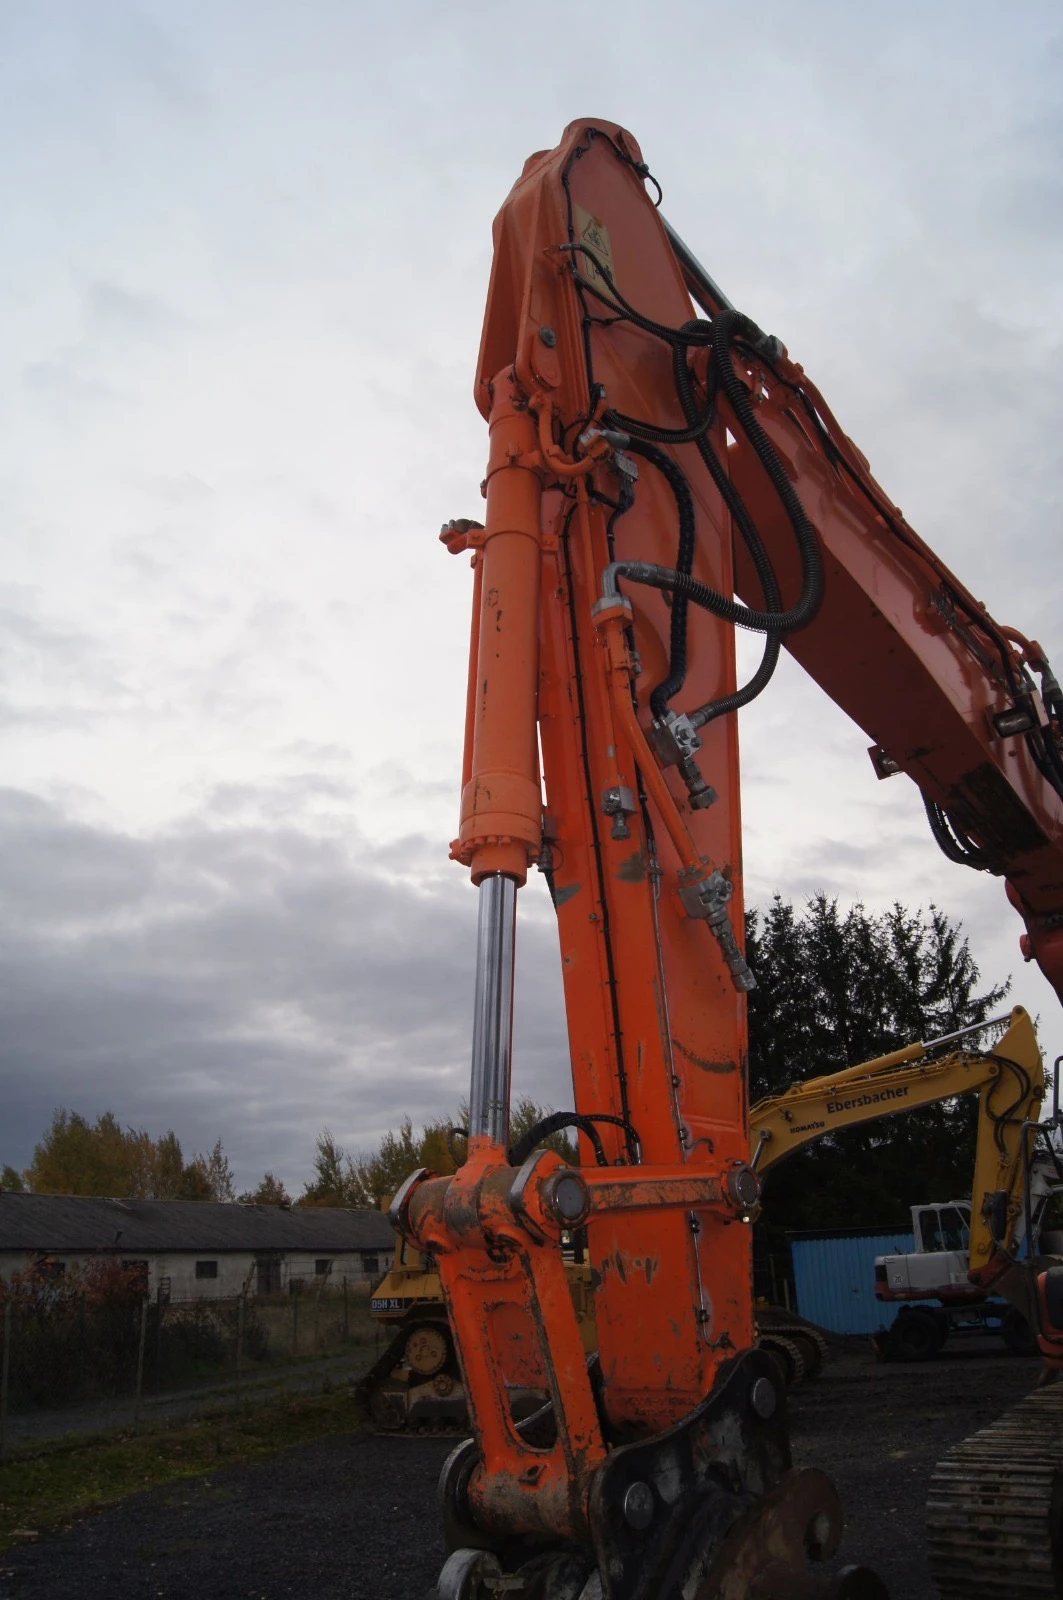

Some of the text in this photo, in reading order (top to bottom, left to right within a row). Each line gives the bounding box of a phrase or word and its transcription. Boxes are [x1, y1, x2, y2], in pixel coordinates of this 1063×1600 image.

[826, 1086, 909, 1114] Ebersbacher
[790, 1121, 825, 1134] KOMATSU
[372, 1299, 400, 1309] D5H XL
